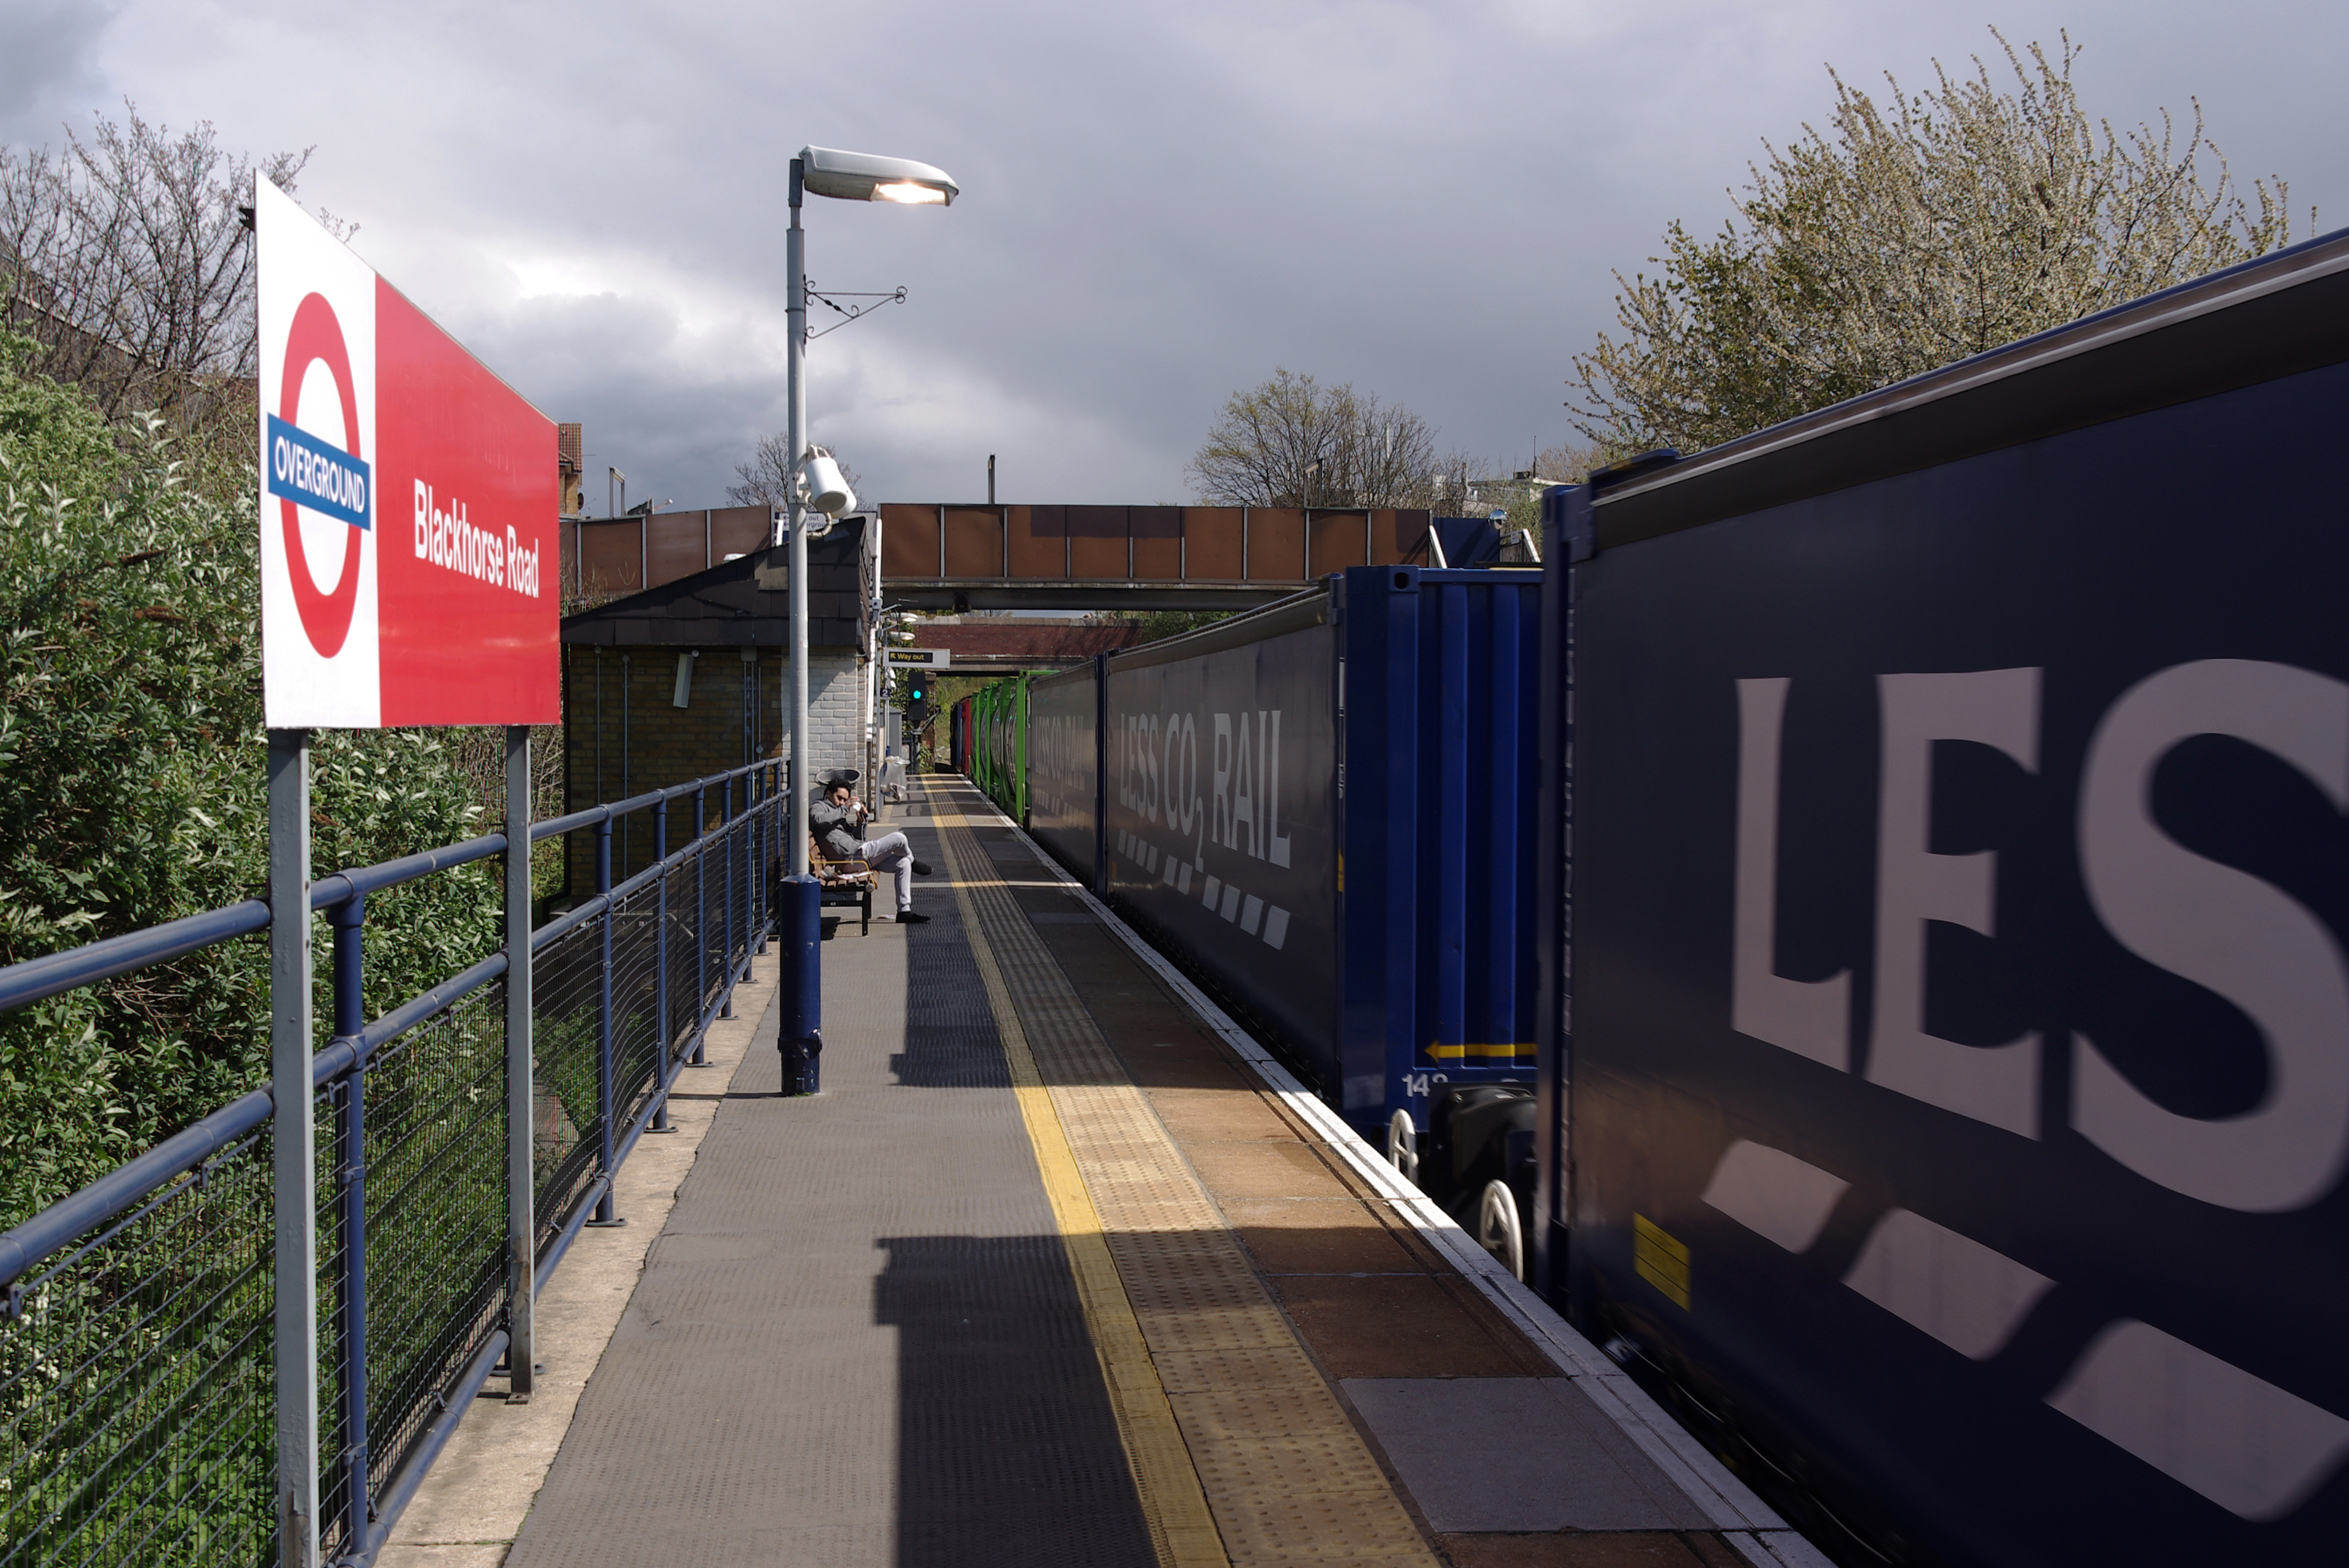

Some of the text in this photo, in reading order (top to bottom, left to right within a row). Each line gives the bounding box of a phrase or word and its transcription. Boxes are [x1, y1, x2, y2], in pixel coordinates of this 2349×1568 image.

[275, 435, 365, 514] OVERGROUND
[415, 477, 539, 599] Blackhorse Road
[897, 653, 911, 661] Way
[1120, 713, 1158, 823] LESS
[1212, 710, 1291, 870] RAIL
